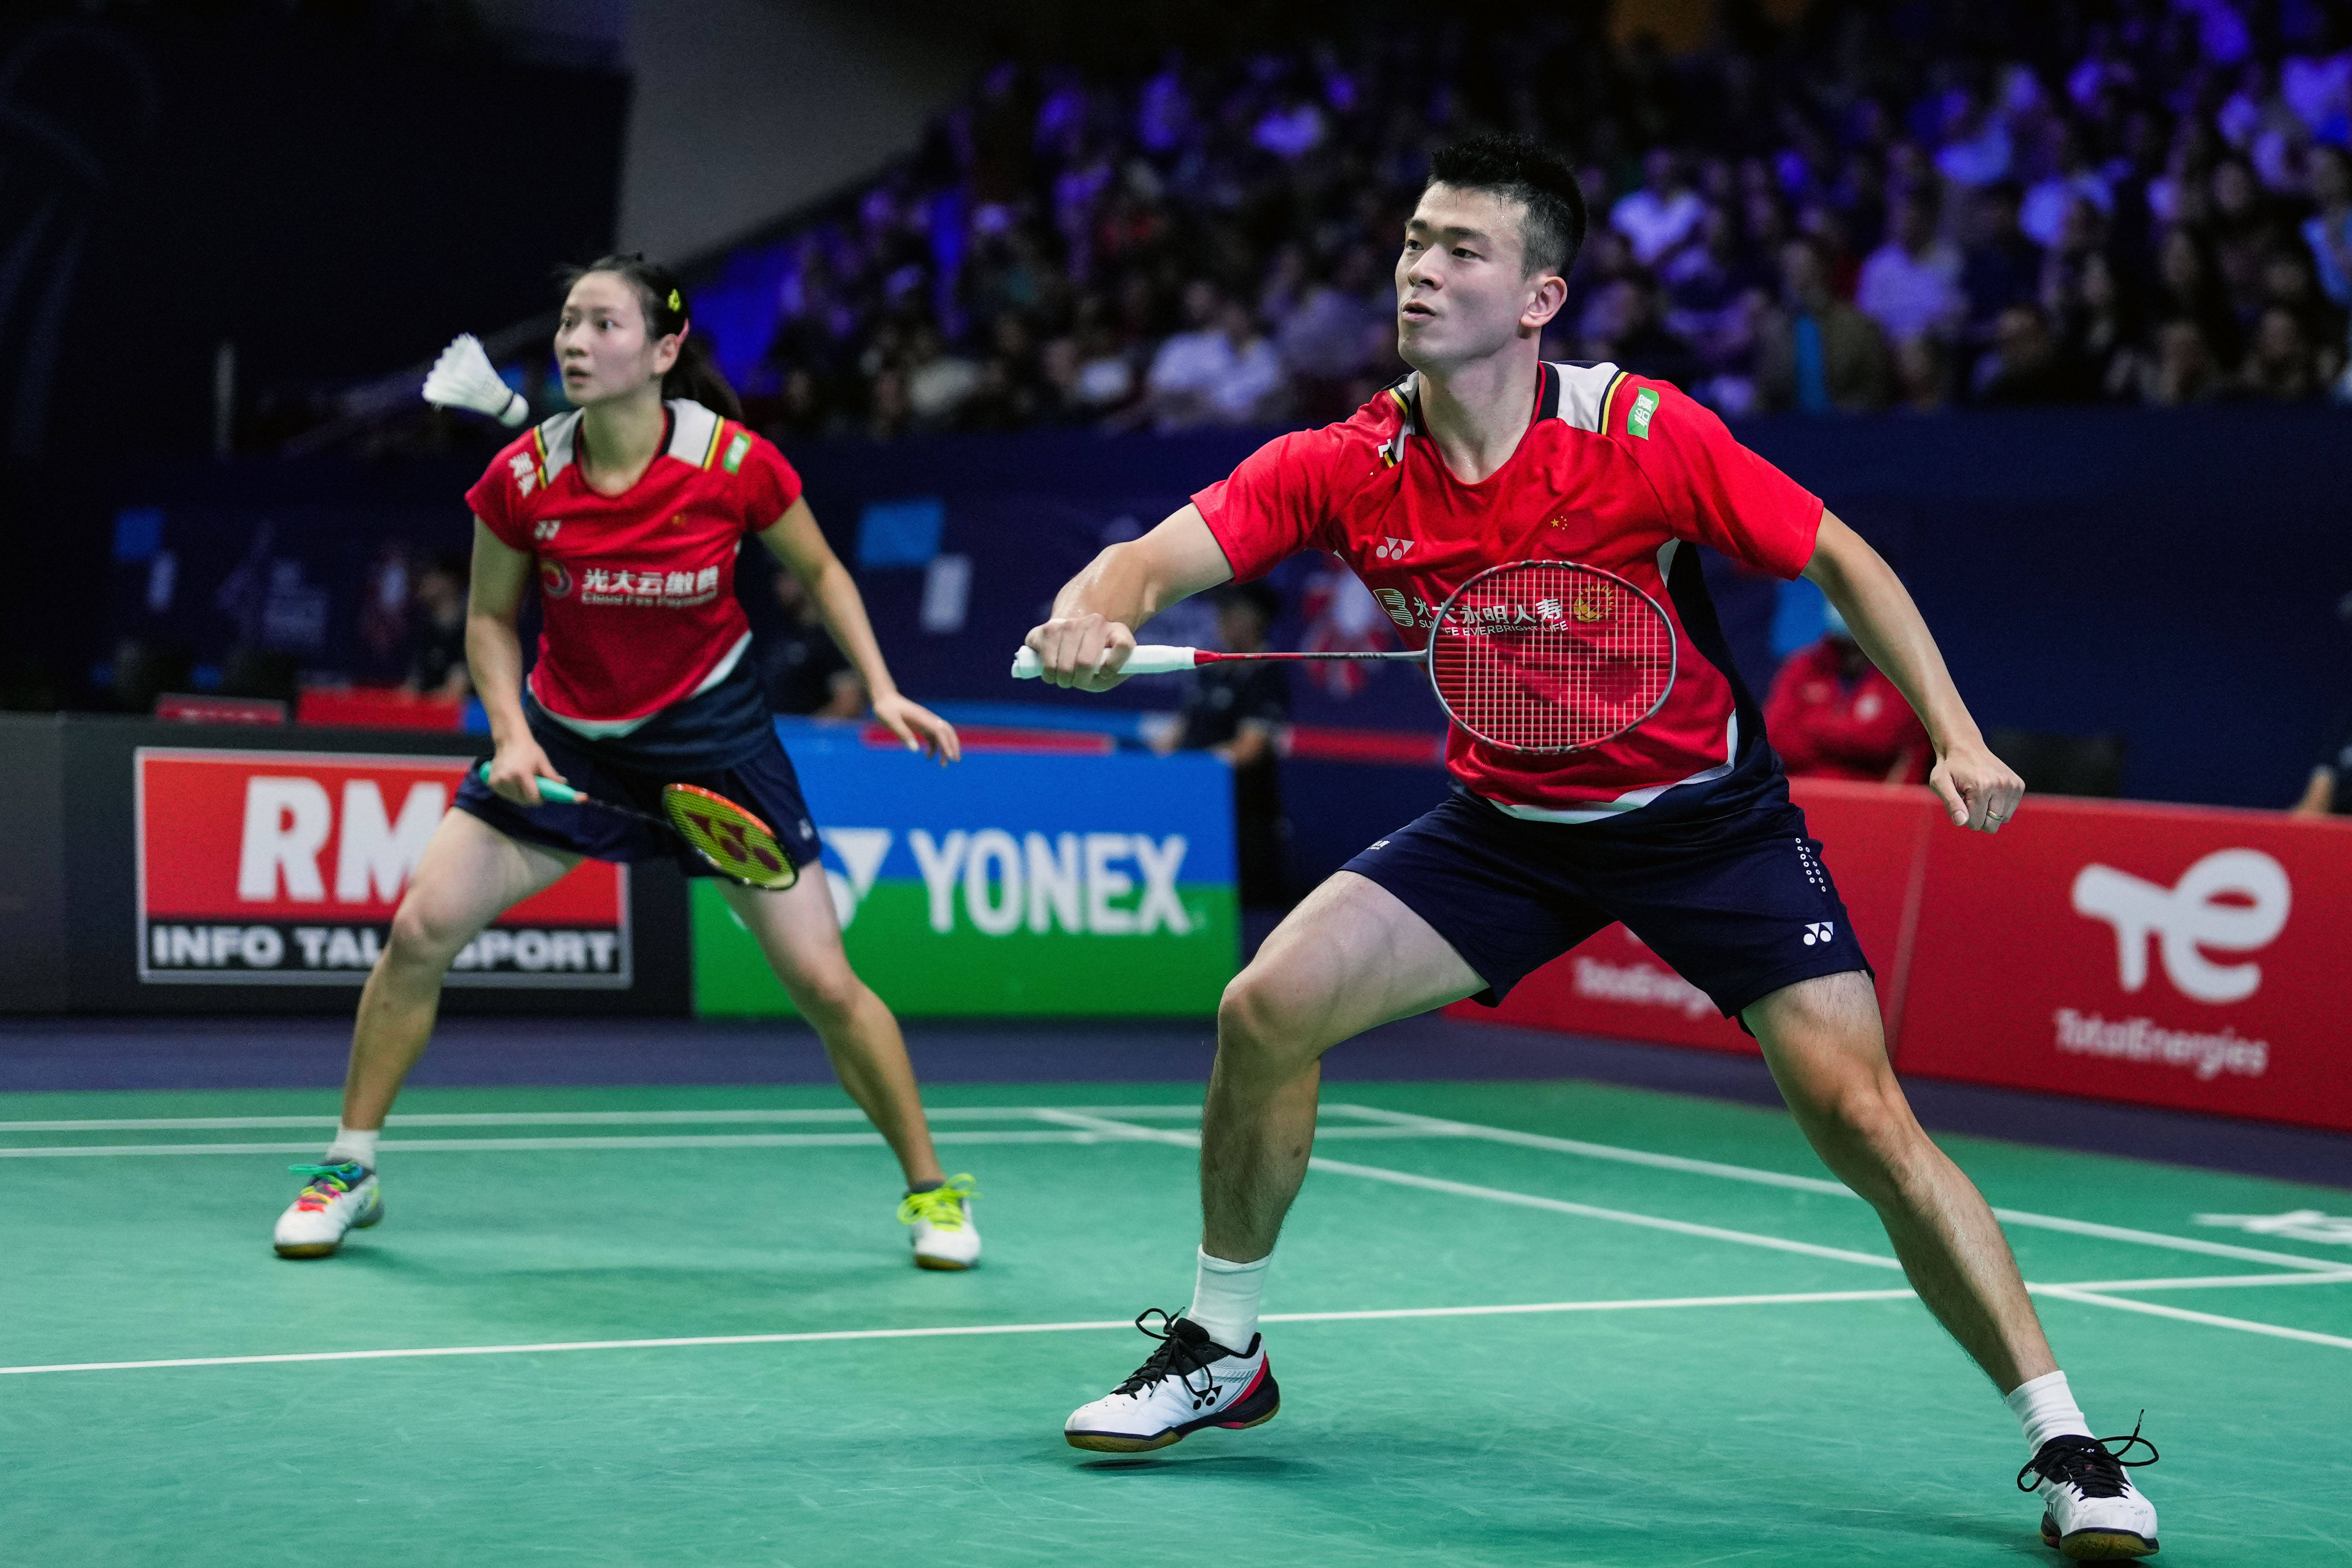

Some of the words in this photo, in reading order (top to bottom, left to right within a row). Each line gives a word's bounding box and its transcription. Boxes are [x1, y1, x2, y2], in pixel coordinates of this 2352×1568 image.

[1413, 597, 1563, 624] 光大永明人寿
[1463, 625, 1538, 636] EVERBRIGHT
[1542, 621, 1568, 632] LIFE
[237, 776, 448, 903] RM
[908, 827, 1192, 936] YONEX
[152, 925, 283, 968] INFO
[294, 926, 384, 968] TAL
